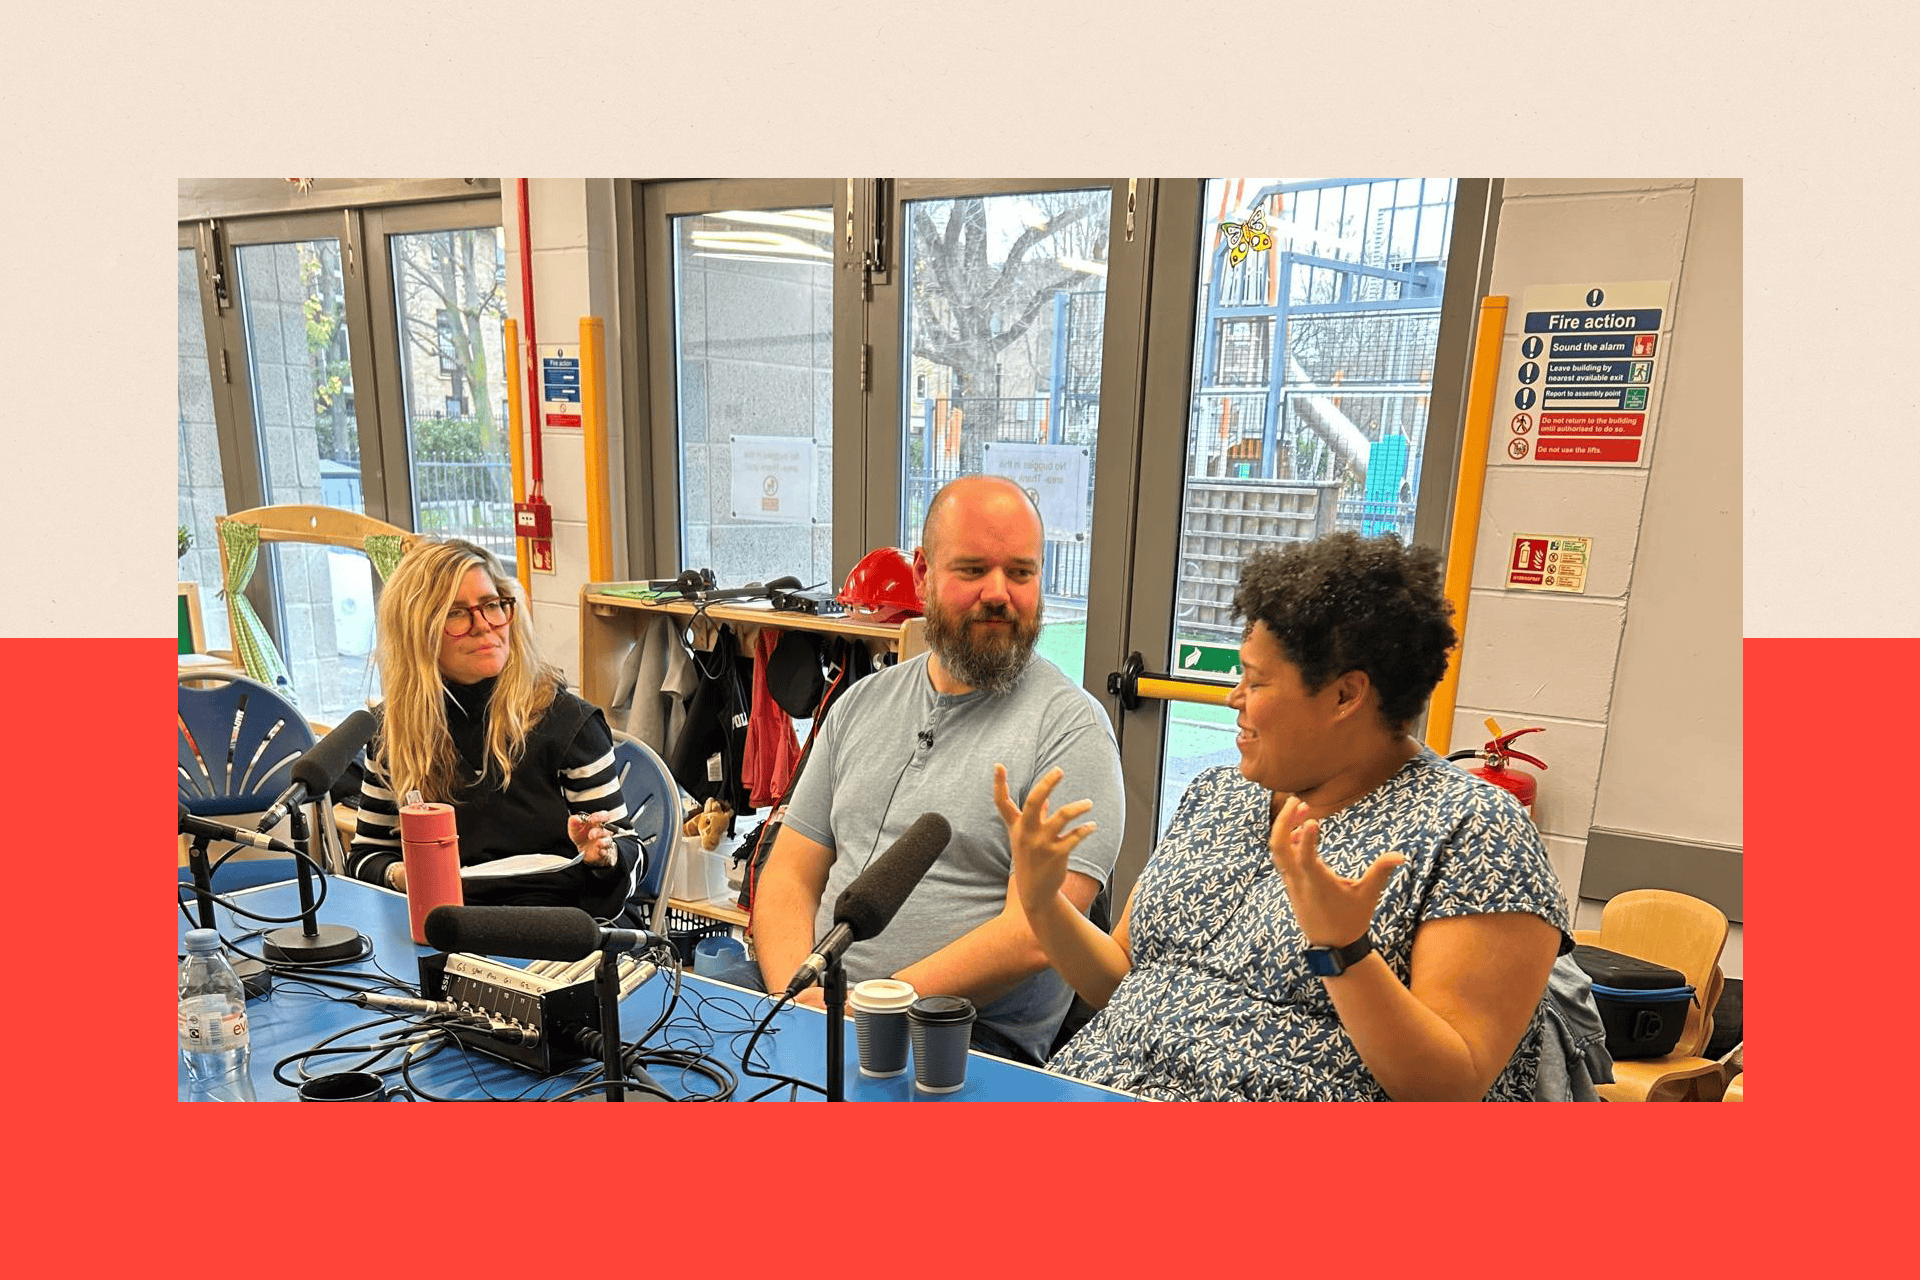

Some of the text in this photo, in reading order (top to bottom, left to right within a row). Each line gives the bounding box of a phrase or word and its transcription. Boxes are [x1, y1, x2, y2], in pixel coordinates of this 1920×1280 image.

[1548, 313, 1636, 330] Fire action
[1552, 341, 1625, 352] Sound the alarm
[1549, 364, 1613, 373] Leave building by
[1548, 374, 1575, 382] nearest
[1545, 390, 1566, 398] Report
[1574, 390, 1603, 398] assembly
[1604, 390, 1621, 398] point
[1608, 418, 1638, 426] building
